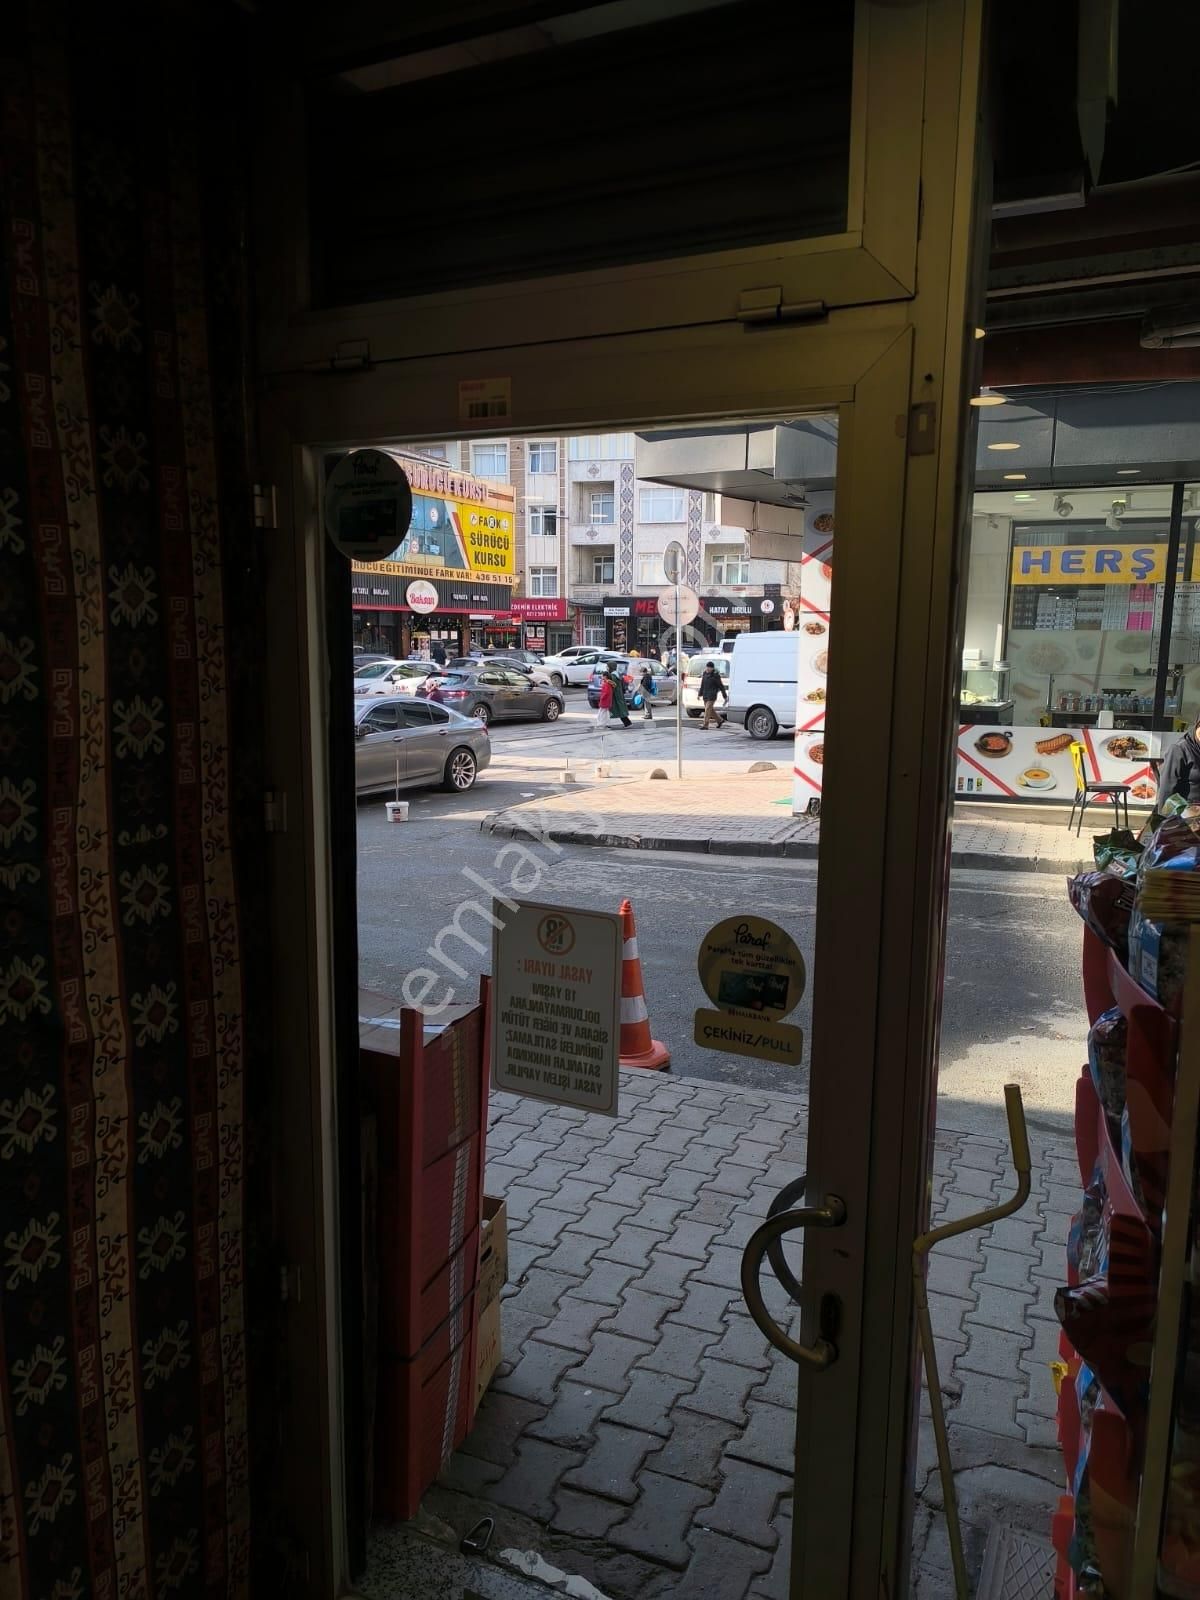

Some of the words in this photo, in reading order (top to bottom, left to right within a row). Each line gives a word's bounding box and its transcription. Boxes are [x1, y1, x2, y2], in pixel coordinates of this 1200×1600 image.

[470, 530, 509, 550] SÜRÜCÜ
[474, 551, 506, 567] KURSU
[435, 569, 455, 578] FARK
[709, 606, 729, 614] HATAY
[734, 923, 771, 951] Paraf
